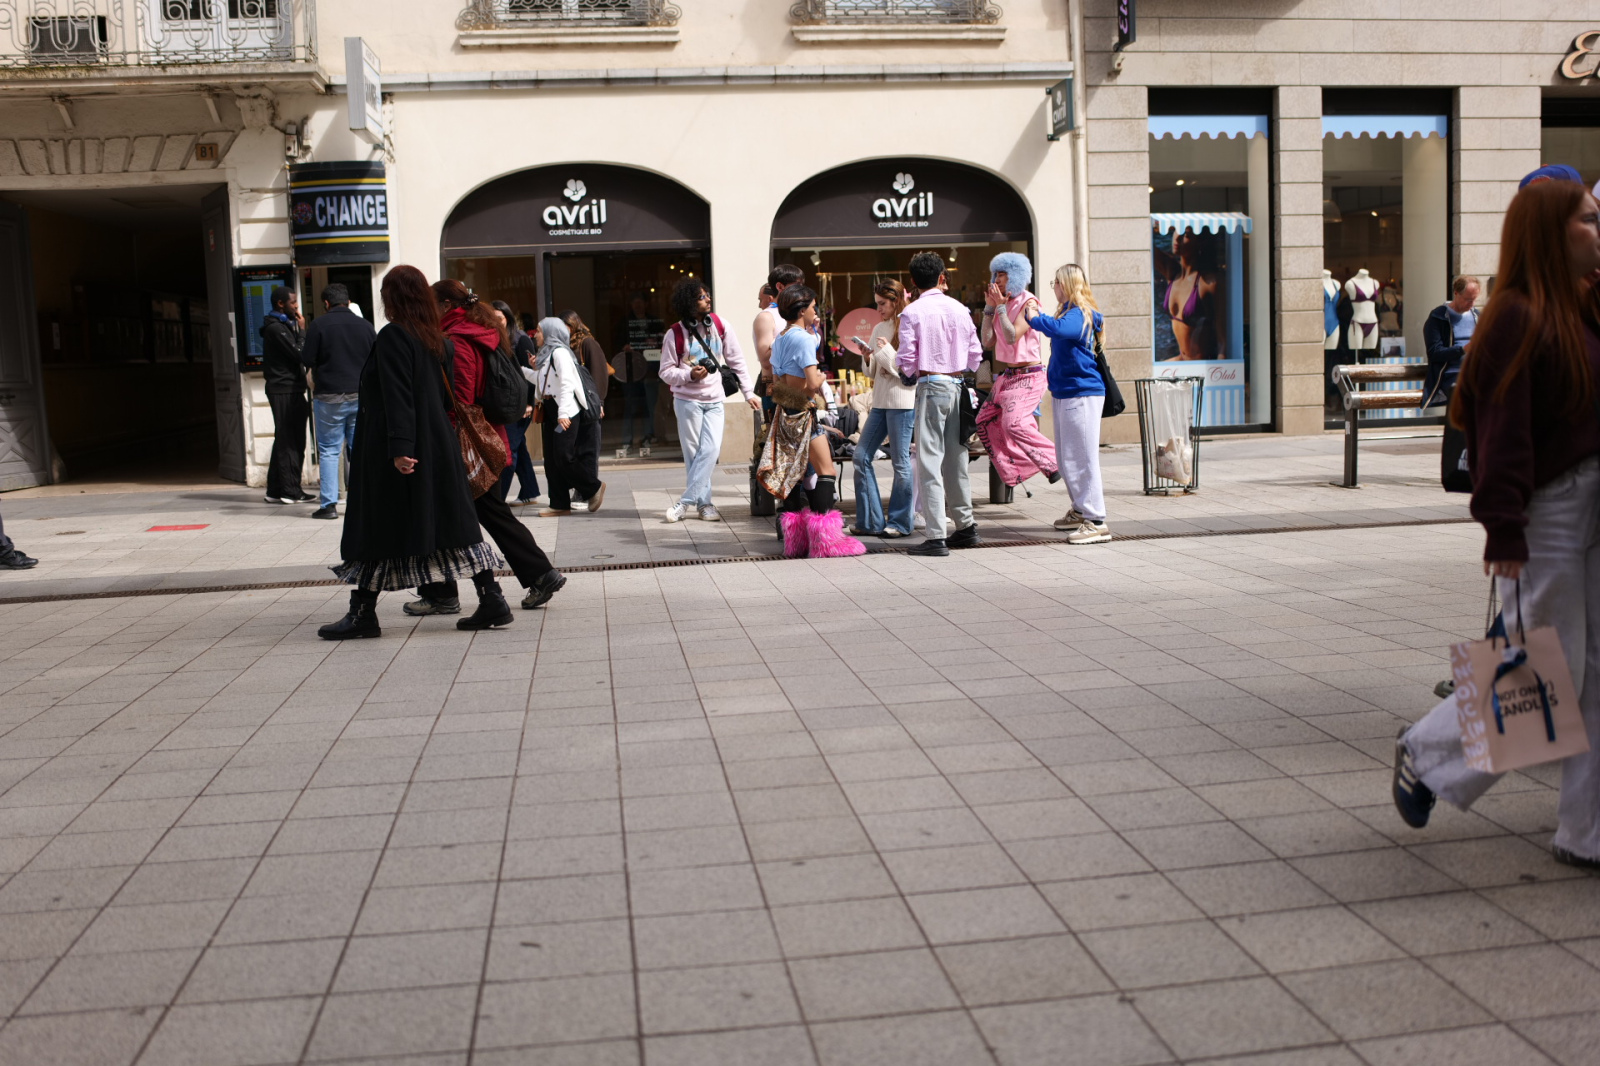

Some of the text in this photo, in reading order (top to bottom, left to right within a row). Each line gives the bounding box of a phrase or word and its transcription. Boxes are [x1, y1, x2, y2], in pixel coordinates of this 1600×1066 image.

[200, 146, 214, 158] 81
[315, 194, 388, 228] CHANGE
[542, 198, 607, 226] avril
[872, 191, 934, 218] avril
[549, 228, 589, 236] COSMÉTIQUE
[878, 220, 929, 228] COSMÉTIQUE BIO
[1208, 366, 1237, 382] Club
[1499, 693, 1559, 719] ANDLS
